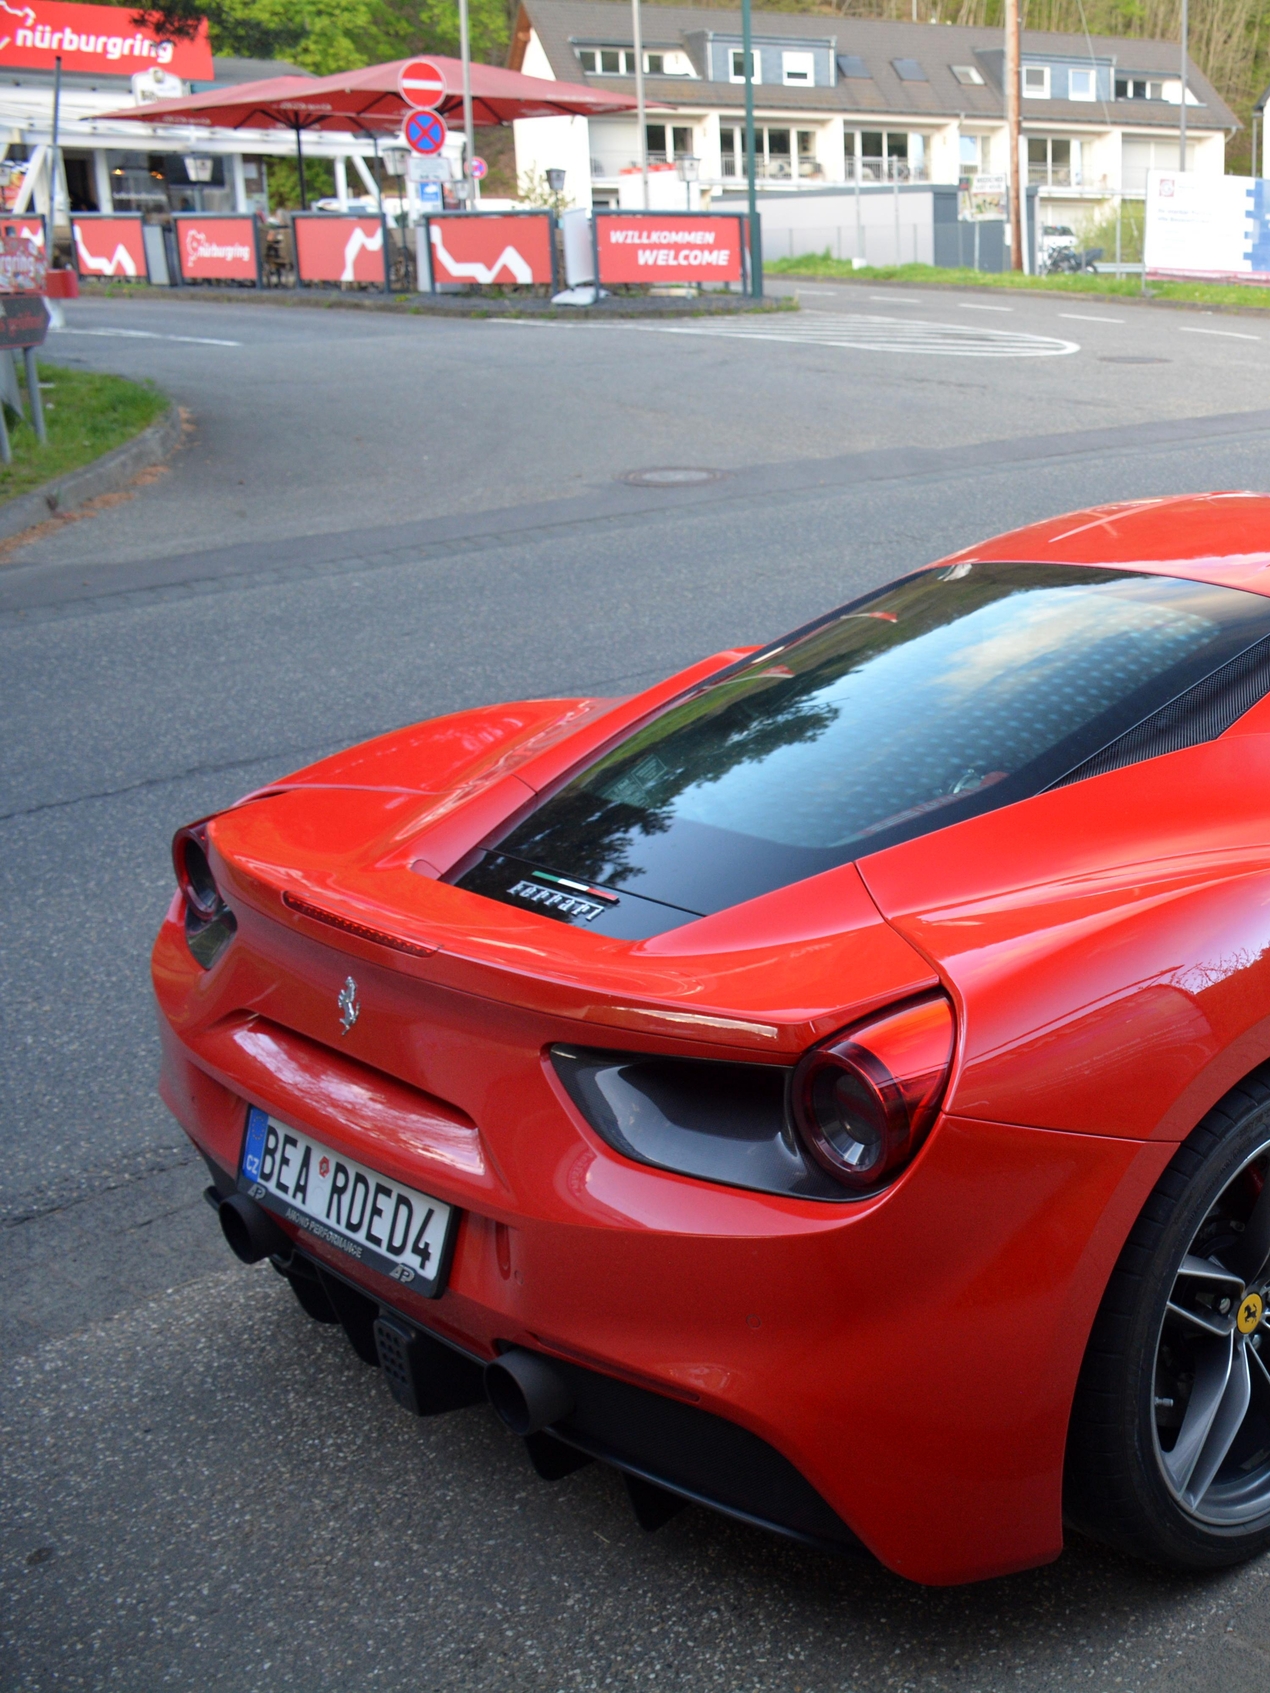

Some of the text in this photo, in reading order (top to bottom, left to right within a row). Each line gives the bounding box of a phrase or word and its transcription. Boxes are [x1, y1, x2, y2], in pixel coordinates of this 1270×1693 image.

[16, 26, 173, 63] nürburgring
[610, 230, 715, 245] WILLKOMMEN
[637, 249, 730, 266] WELCOME
[506, 880, 605, 921] Ferrari
[246, 1154, 260, 1175] CZ
[259, 1125, 435, 1270] BEA RDED4
